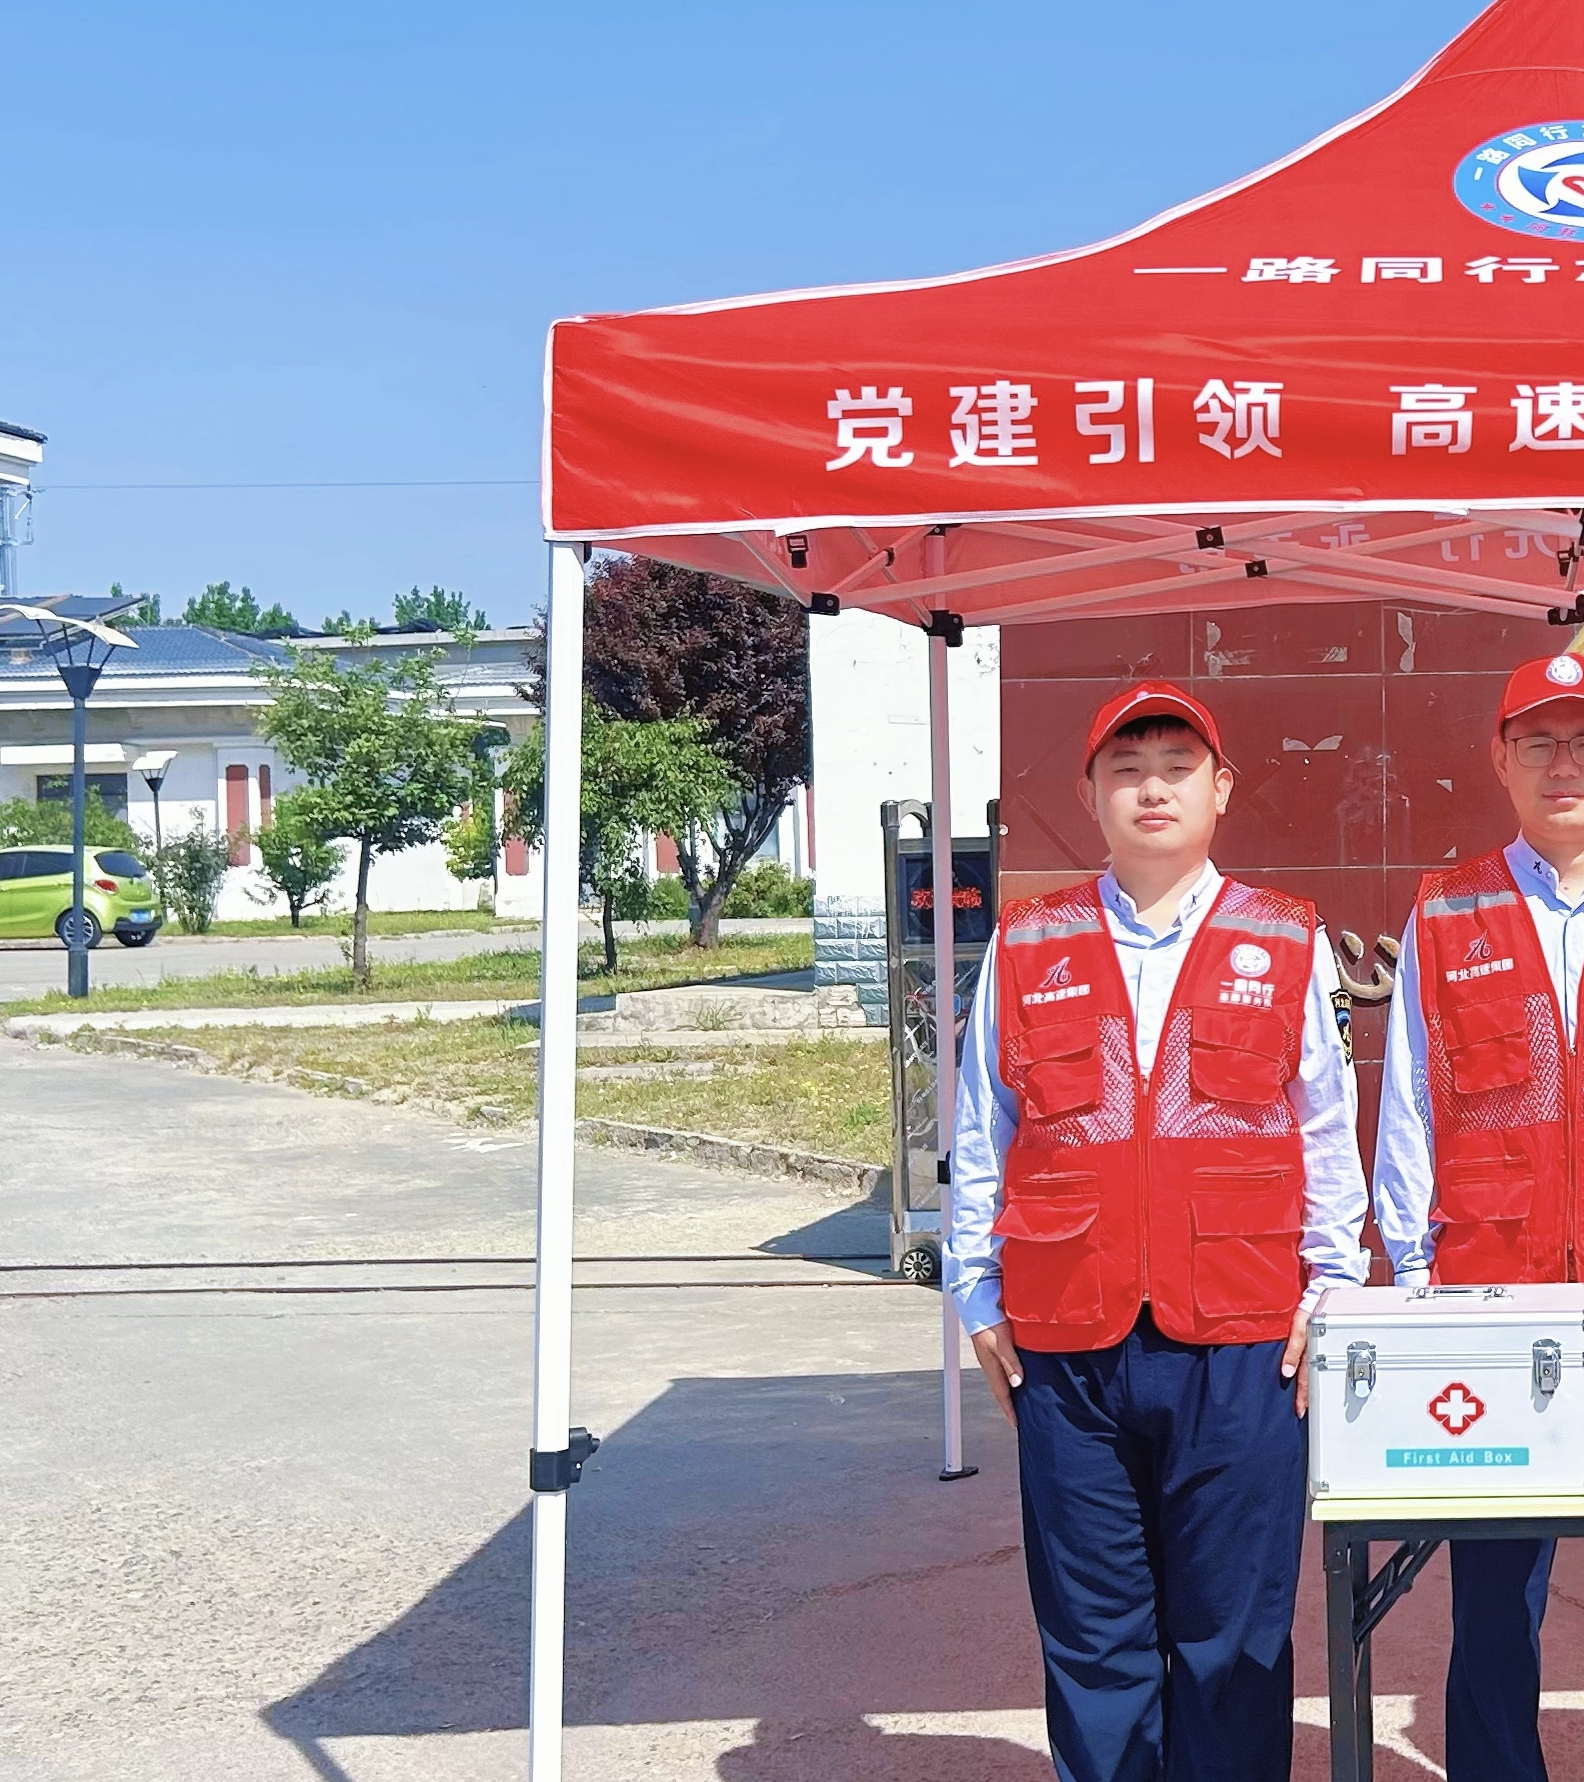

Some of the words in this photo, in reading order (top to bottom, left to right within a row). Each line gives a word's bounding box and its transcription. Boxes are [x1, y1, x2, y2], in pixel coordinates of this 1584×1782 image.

[825, 378, 1284, 471] 党建引领
[1403, 1451, 1441, 1464] First
[1449, 1451, 1474, 1464] Aid
[1484, 1450, 1513, 1464] Box
